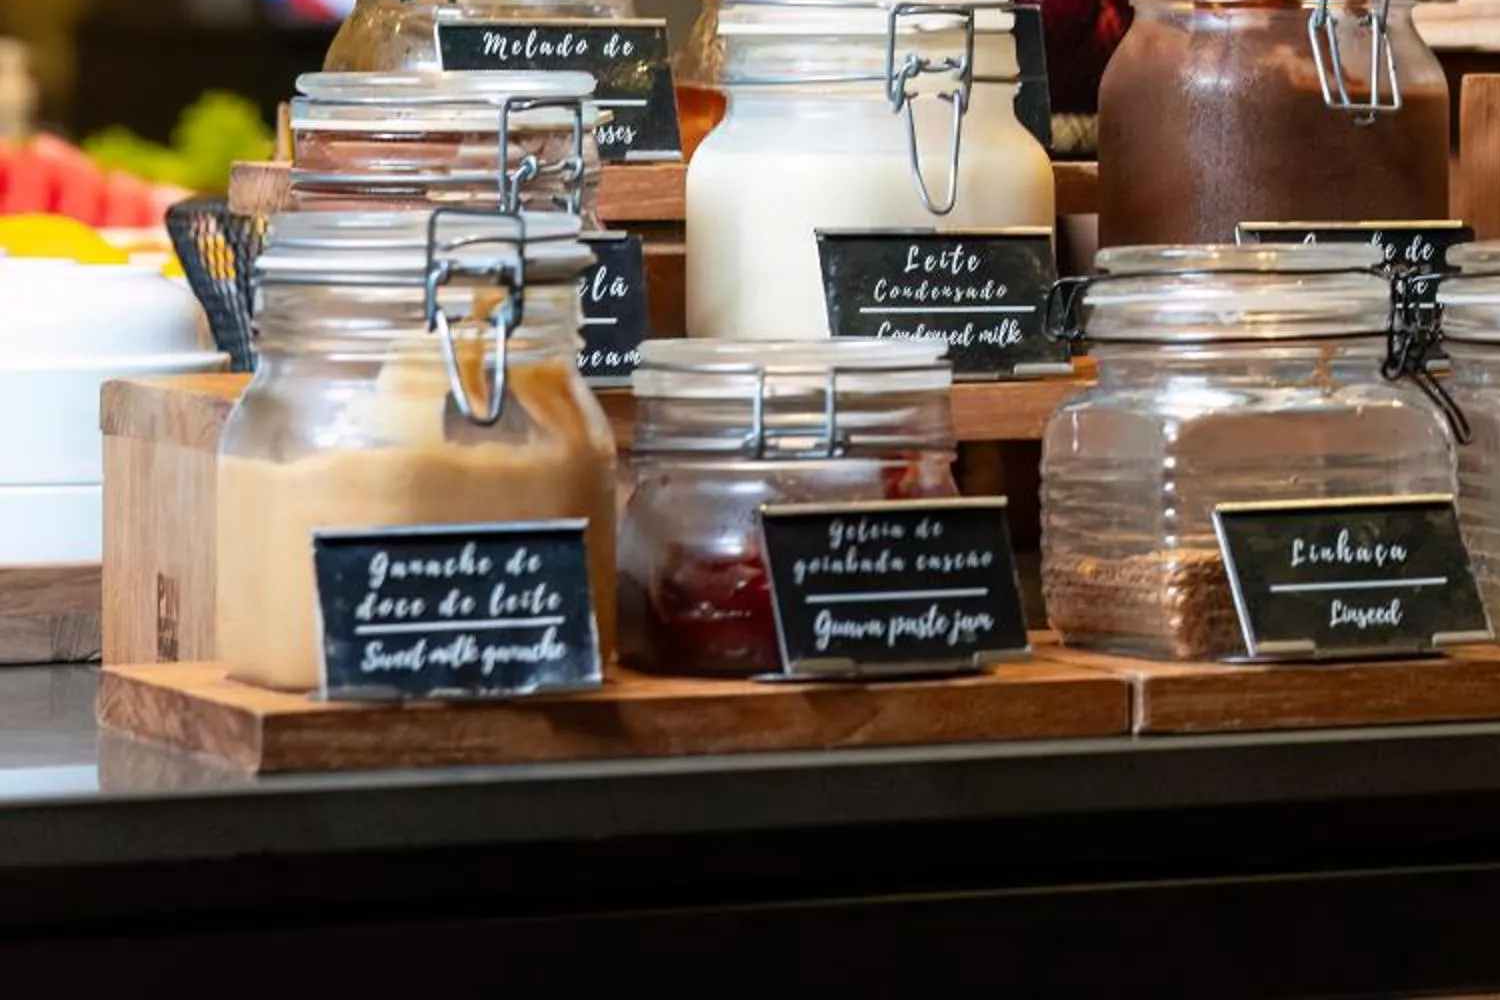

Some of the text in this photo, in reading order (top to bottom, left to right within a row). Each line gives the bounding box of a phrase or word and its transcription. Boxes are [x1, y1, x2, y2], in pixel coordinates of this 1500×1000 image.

[483, 28, 635, 61] Melado de
[904, 244, 981, 275] Leite
[873, 279, 1008, 303] Condensado
[978, 318, 1024, 348] milk
[829, 516, 944, 549] Geleia de
[1291, 528, 1408, 568] Linhaça
[369, 541, 542, 589] Ganache de
[793, 545, 905, 584] goiabada
[355, 582, 563, 621] doce de leite
[1329, 599, 1403, 629] Linseed
[814, 603, 995, 650] Guava paste jam
